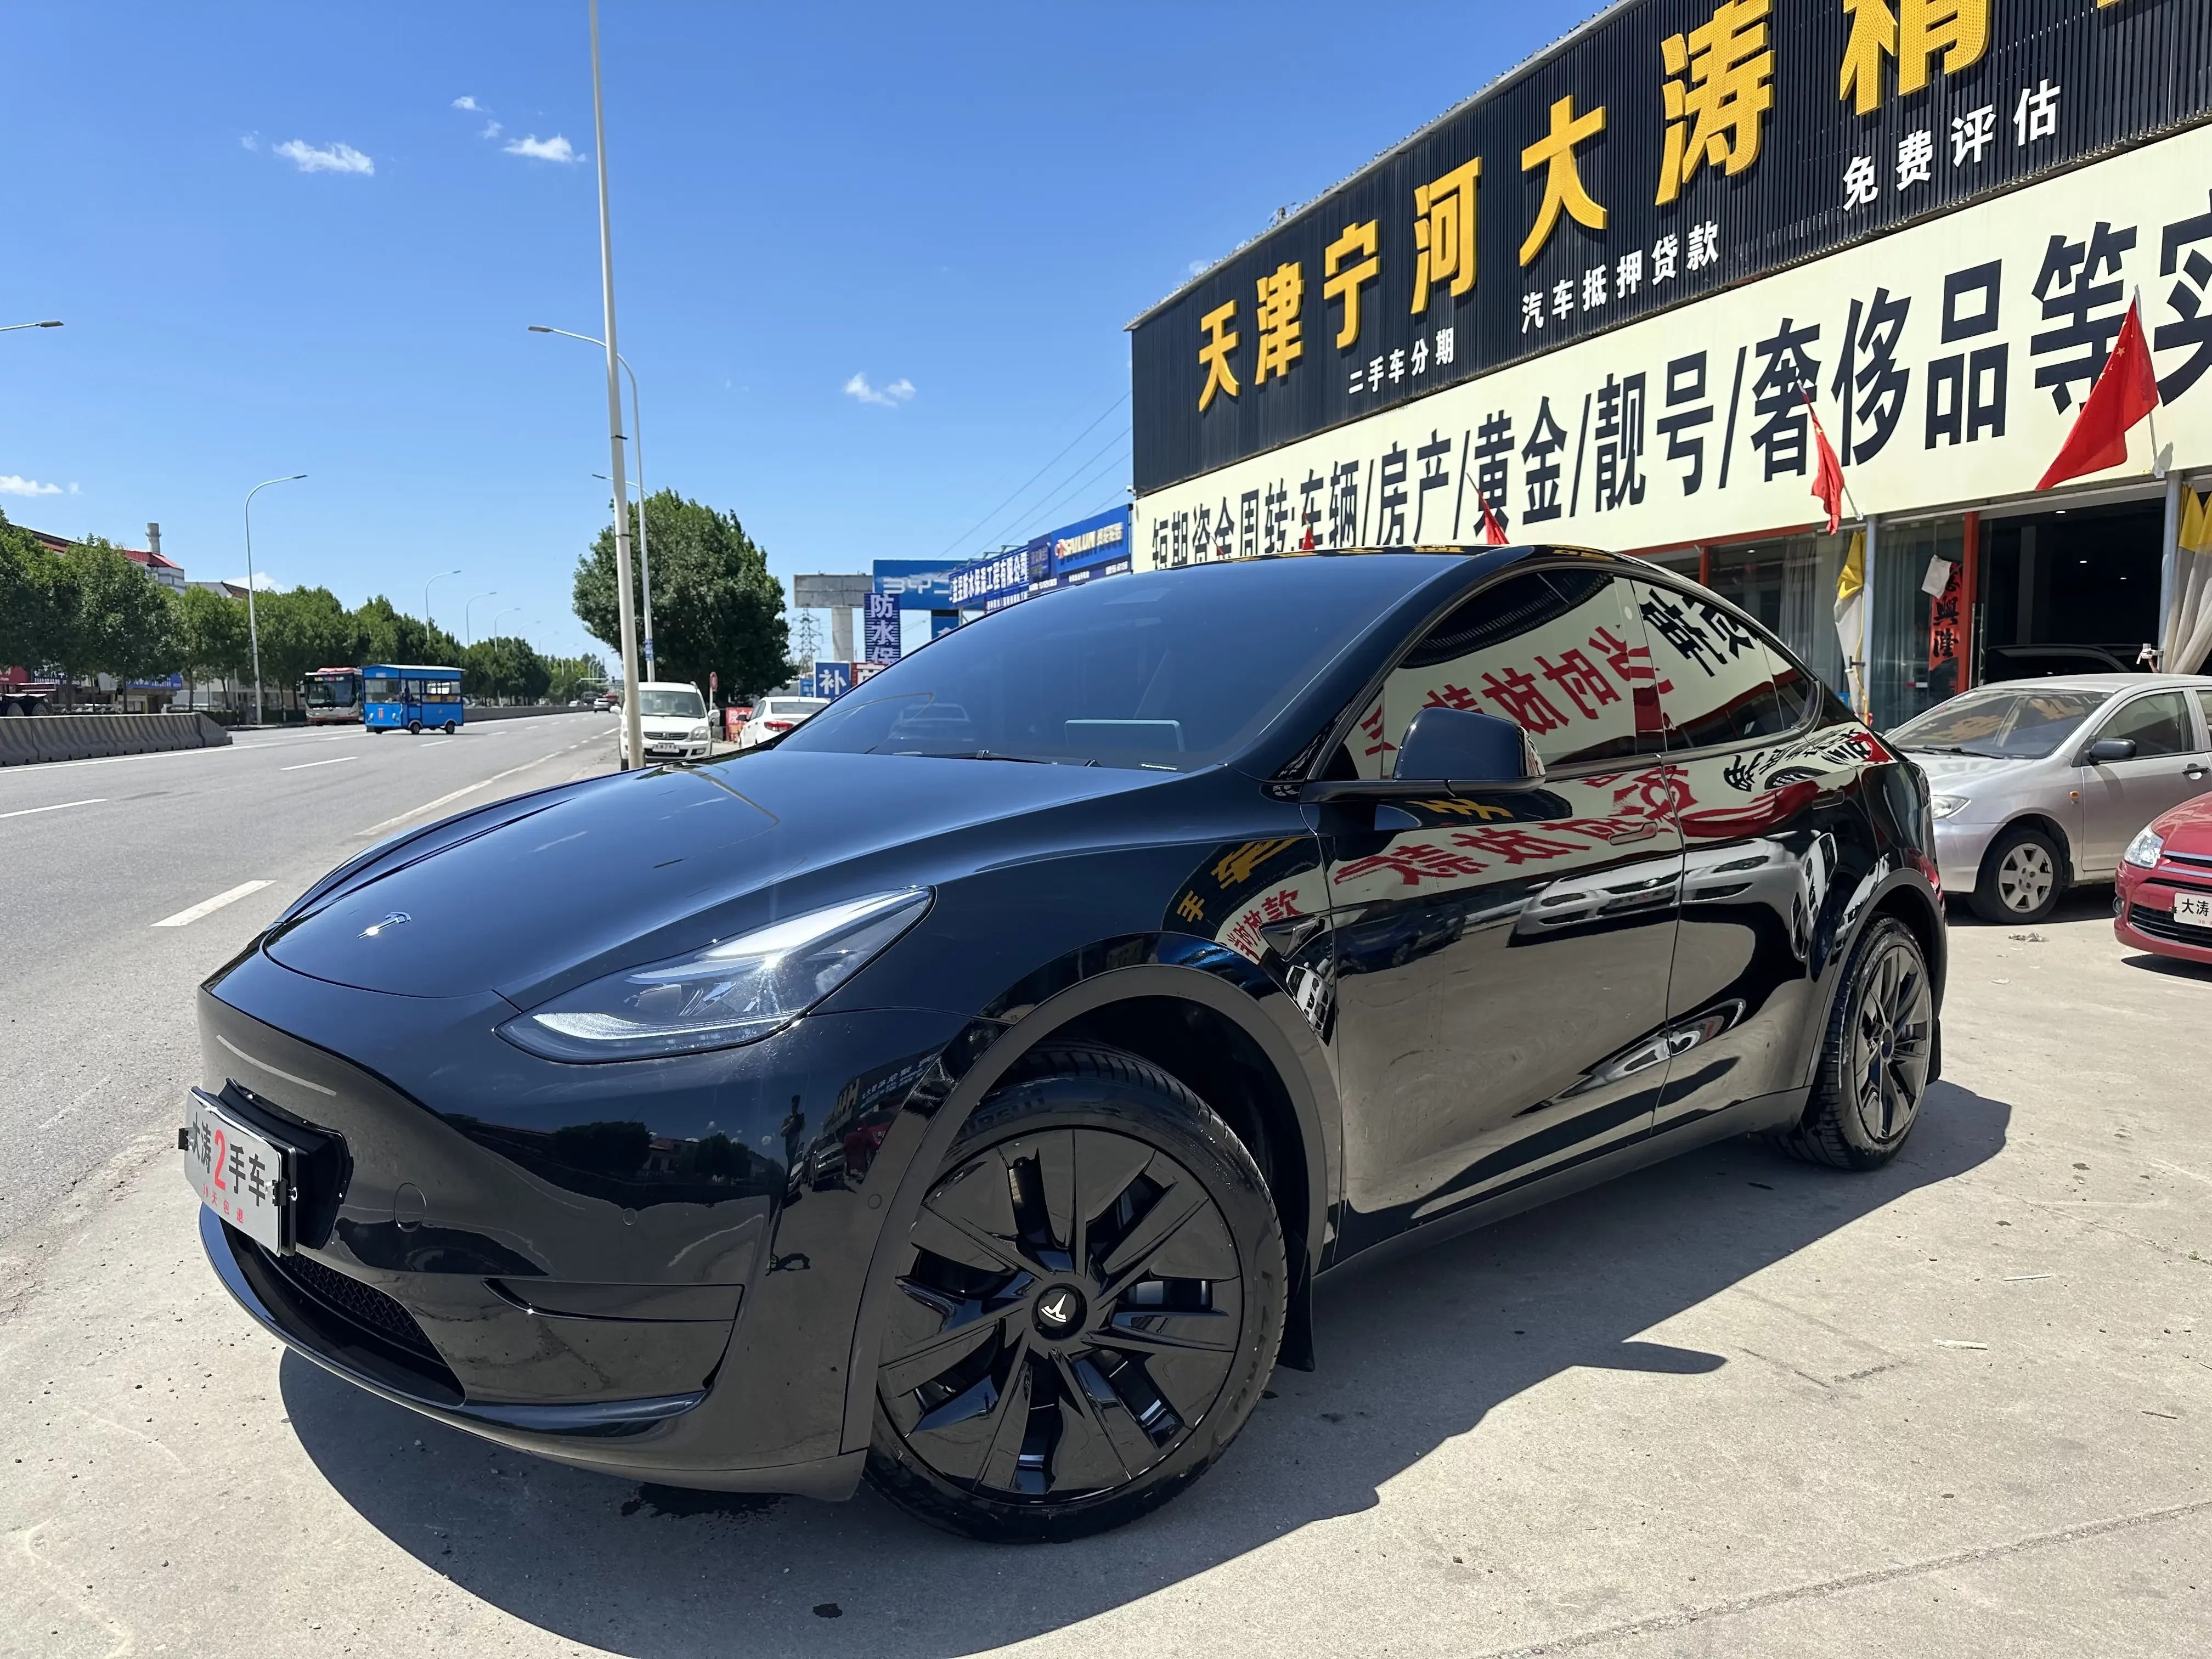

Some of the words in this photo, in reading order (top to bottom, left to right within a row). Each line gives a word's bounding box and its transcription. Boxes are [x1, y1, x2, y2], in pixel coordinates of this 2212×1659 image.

[1198, 0, 2122, 413] 天津宁河大涛精
[1348, 328, 1454, 394] 二手车分期
[1521, 221, 1718, 334] 汽车抵押贷款
[1843, 78, 2060, 211] 免费评估
[2182, 899, 2209, 917] 大涛
[193, 1111, 266, 1206] 大涛2手车
